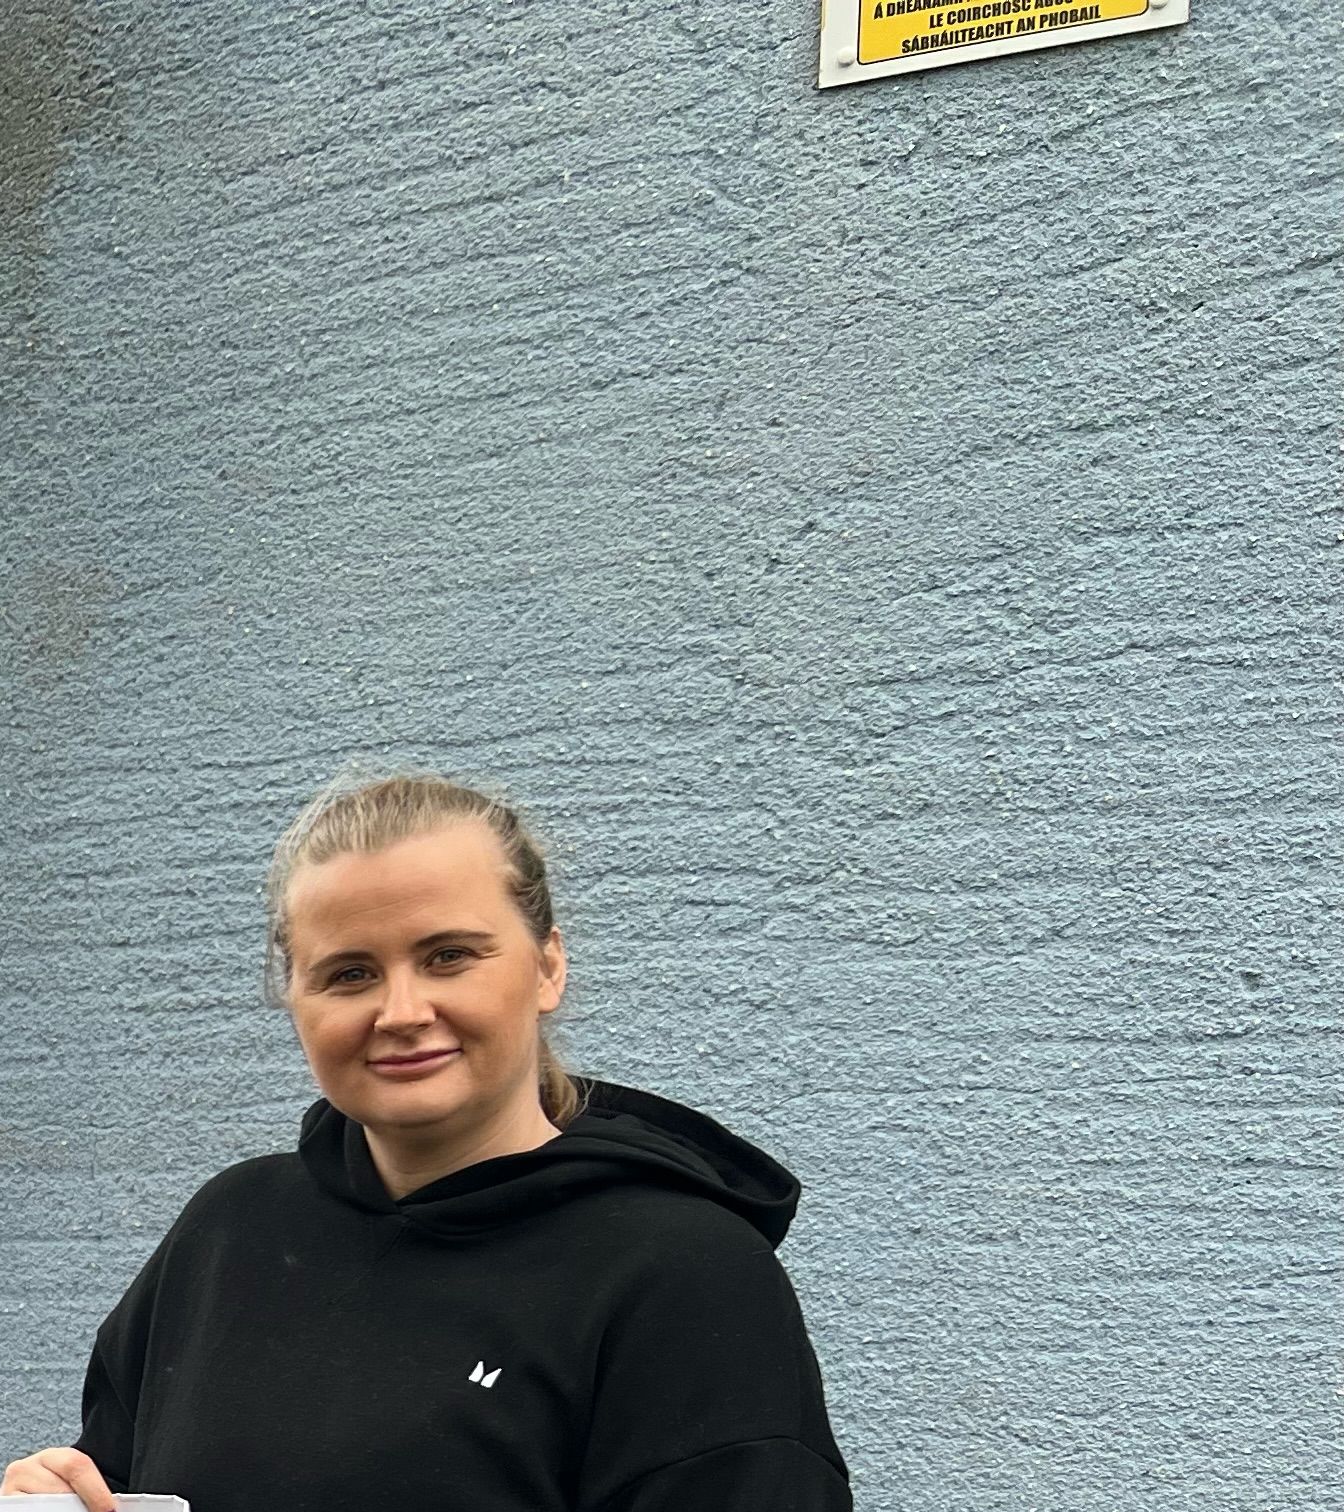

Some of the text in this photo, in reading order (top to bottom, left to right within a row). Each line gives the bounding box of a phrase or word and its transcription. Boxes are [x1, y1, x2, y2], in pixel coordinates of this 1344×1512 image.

[901, 5, 1101, 54] SÁBHÁILTEACHT AN PHOBAIL
[929, 13, 944, 29] LE
